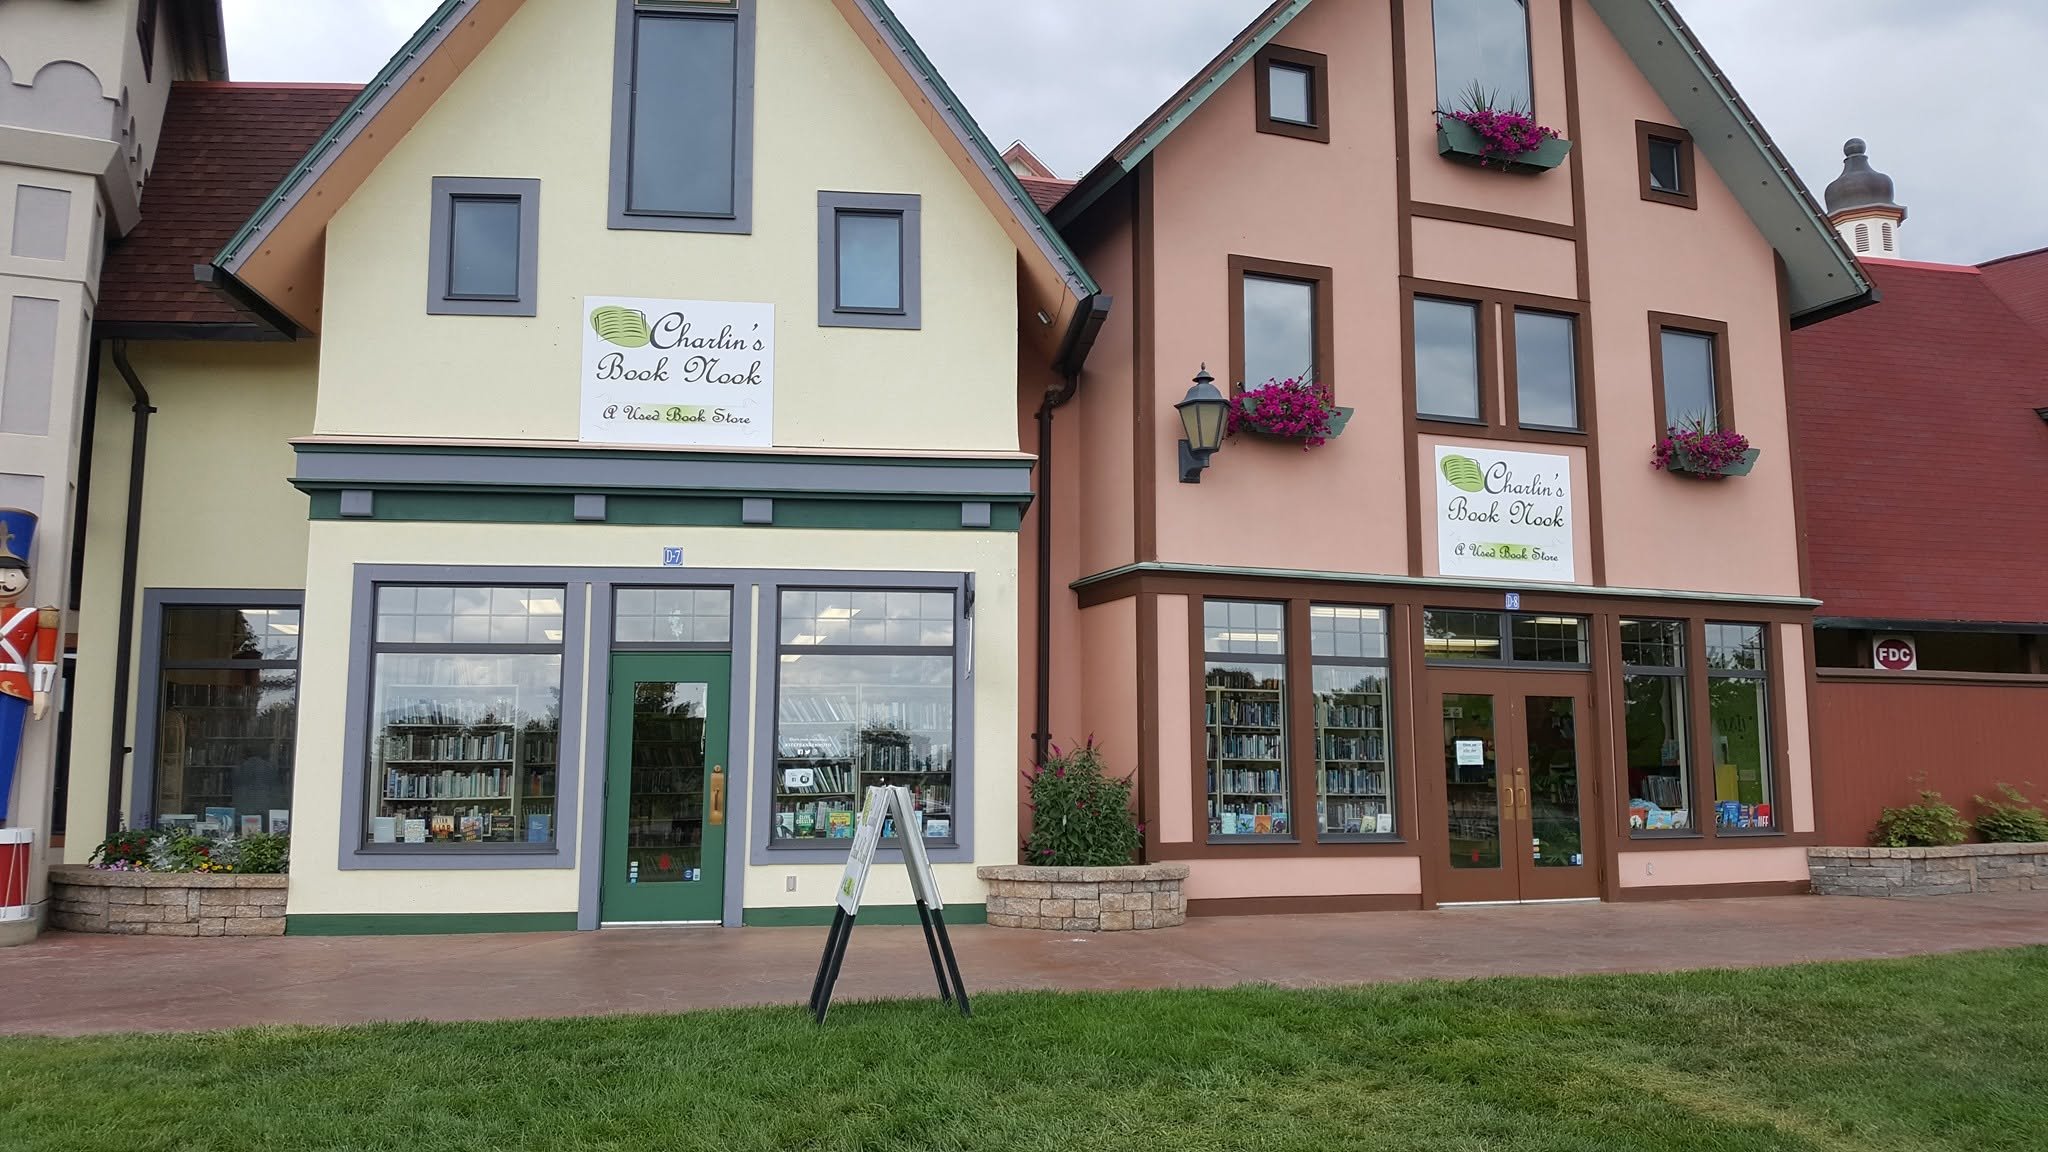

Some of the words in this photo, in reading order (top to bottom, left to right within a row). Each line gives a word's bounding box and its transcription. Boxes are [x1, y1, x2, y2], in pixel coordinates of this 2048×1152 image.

[650, 312, 765, 351] Charlin's
[596, 352, 669, 381] Book
[684, 355, 762, 385] Nook
[603, 404, 618, 420] A
[623, 405, 660, 421] Used
[666, 406, 706, 423] Book
[712, 408, 751, 424] Store
[1484, 461, 1565, 497] Charlin's
[1448, 496, 1500, 523] Book
[1509, 500, 1565, 527] Nook
[666, 549, 681, 563] D-7
[1454, 543, 1465, 556] A
[1469, 543, 1496, 558] Used
[1499, 545, 1528, 560] Book
[1531, 547, 1559, 562] Store
[1878, 647, 1911, 662] FDC
